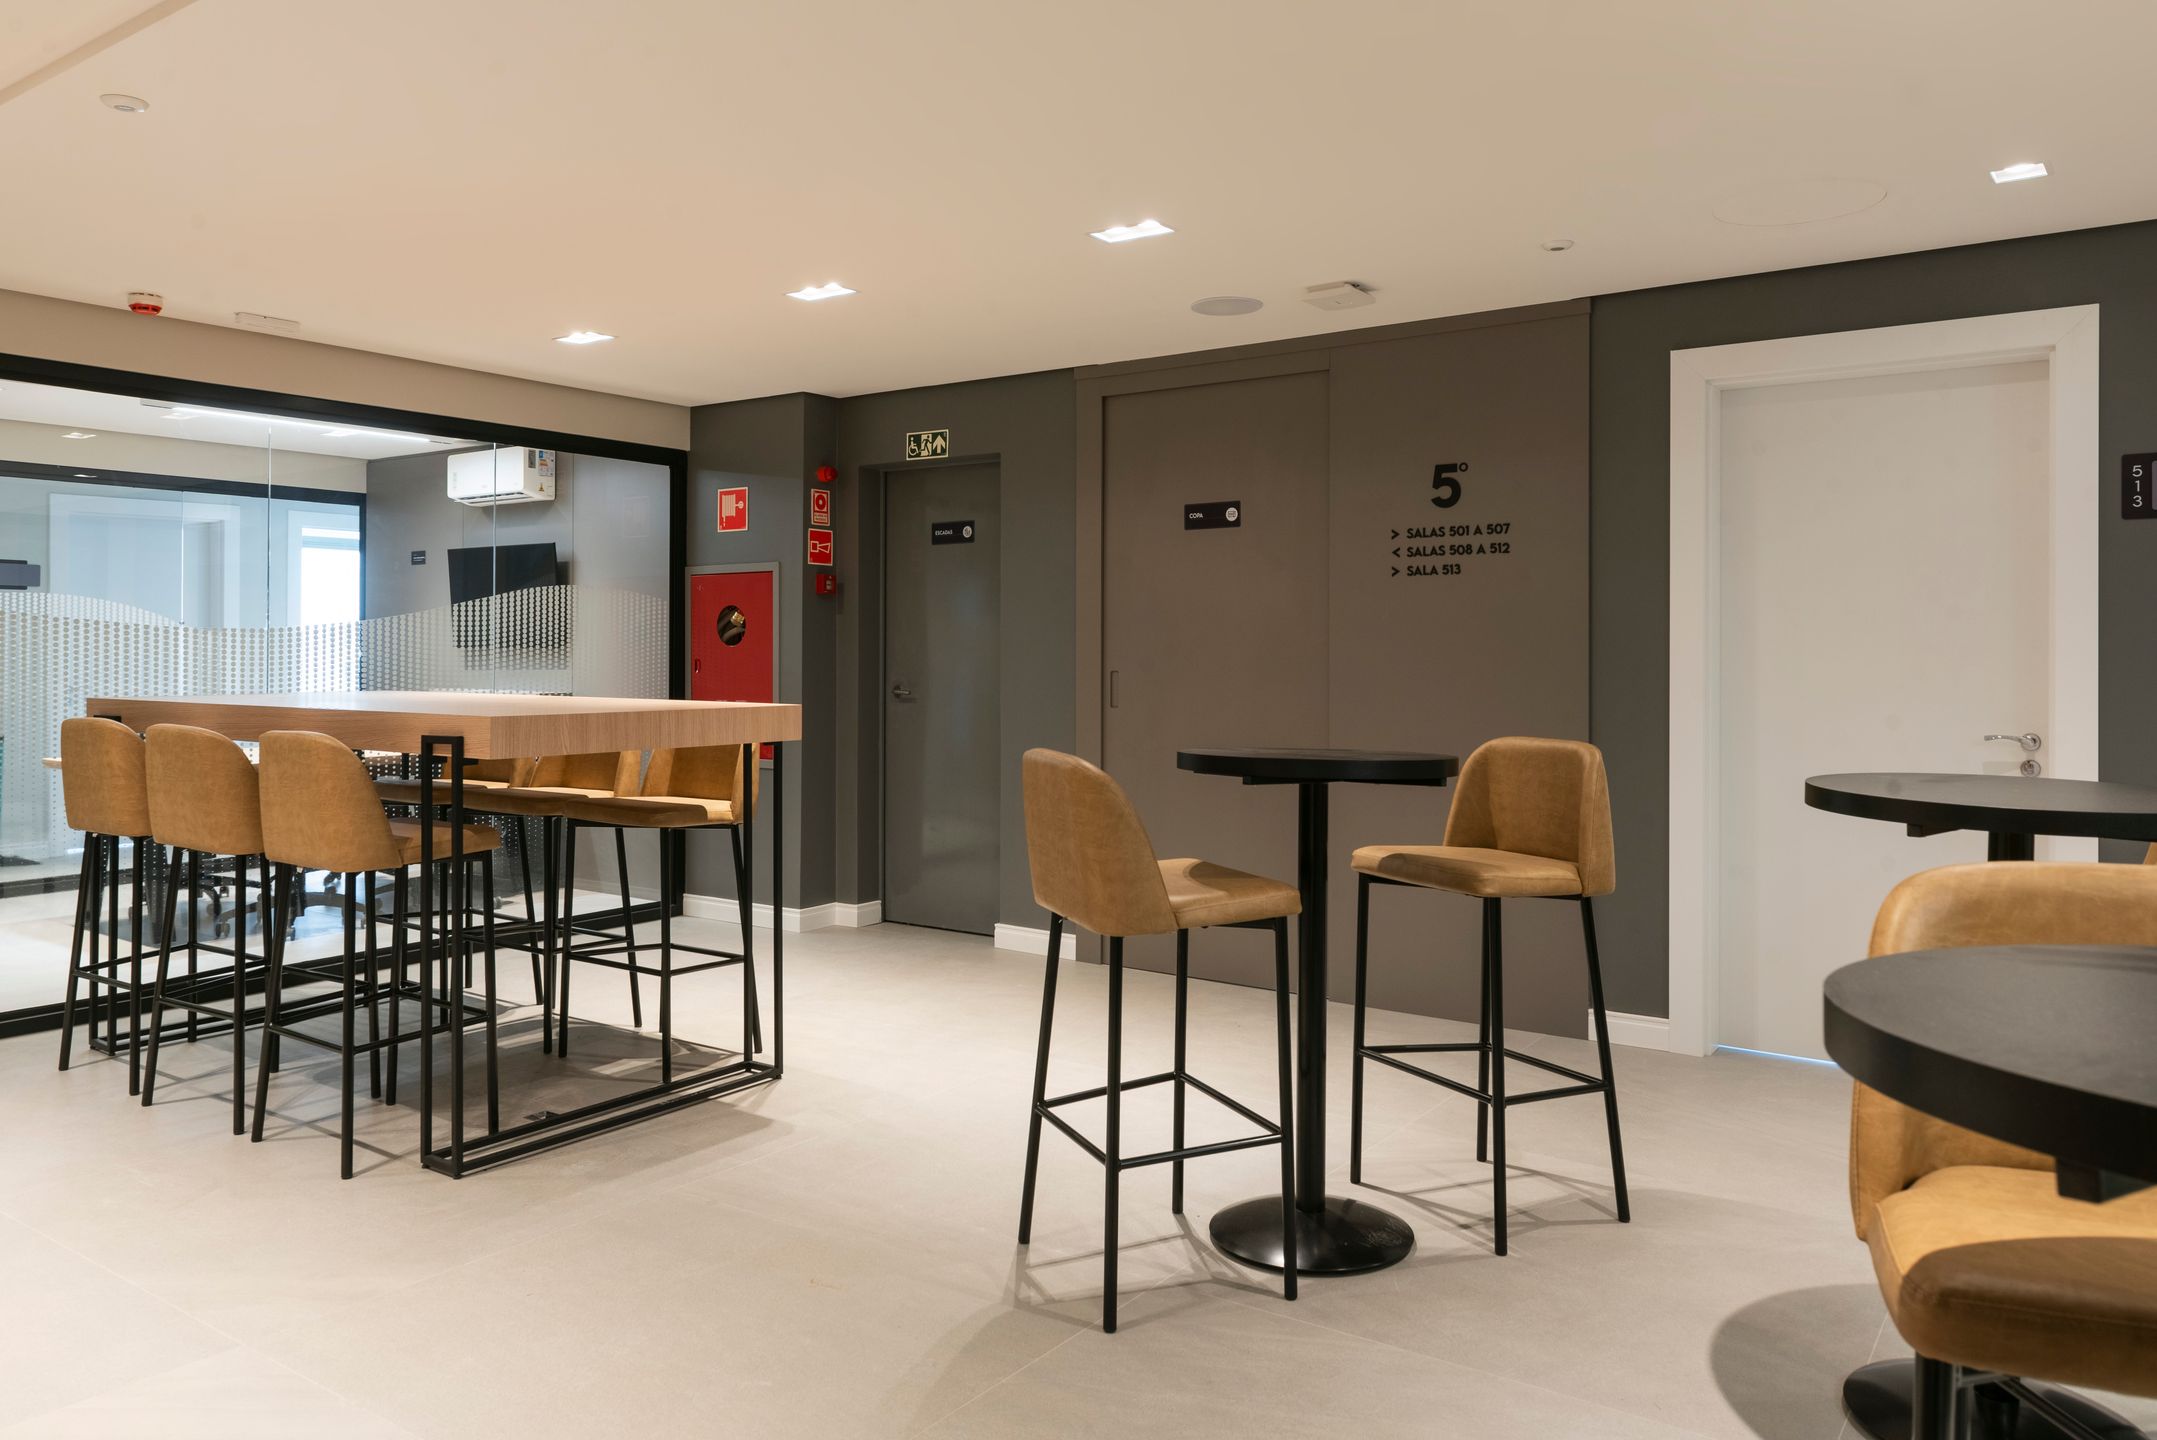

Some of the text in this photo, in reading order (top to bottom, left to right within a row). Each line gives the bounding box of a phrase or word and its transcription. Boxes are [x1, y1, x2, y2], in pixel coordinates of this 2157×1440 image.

[1406, 523, 1511, 539] SALAS 501 A 507
[1406, 542, 1511, 558] SALAS 508 A 512
[1406, 563, 1462, 577] SALA 513
